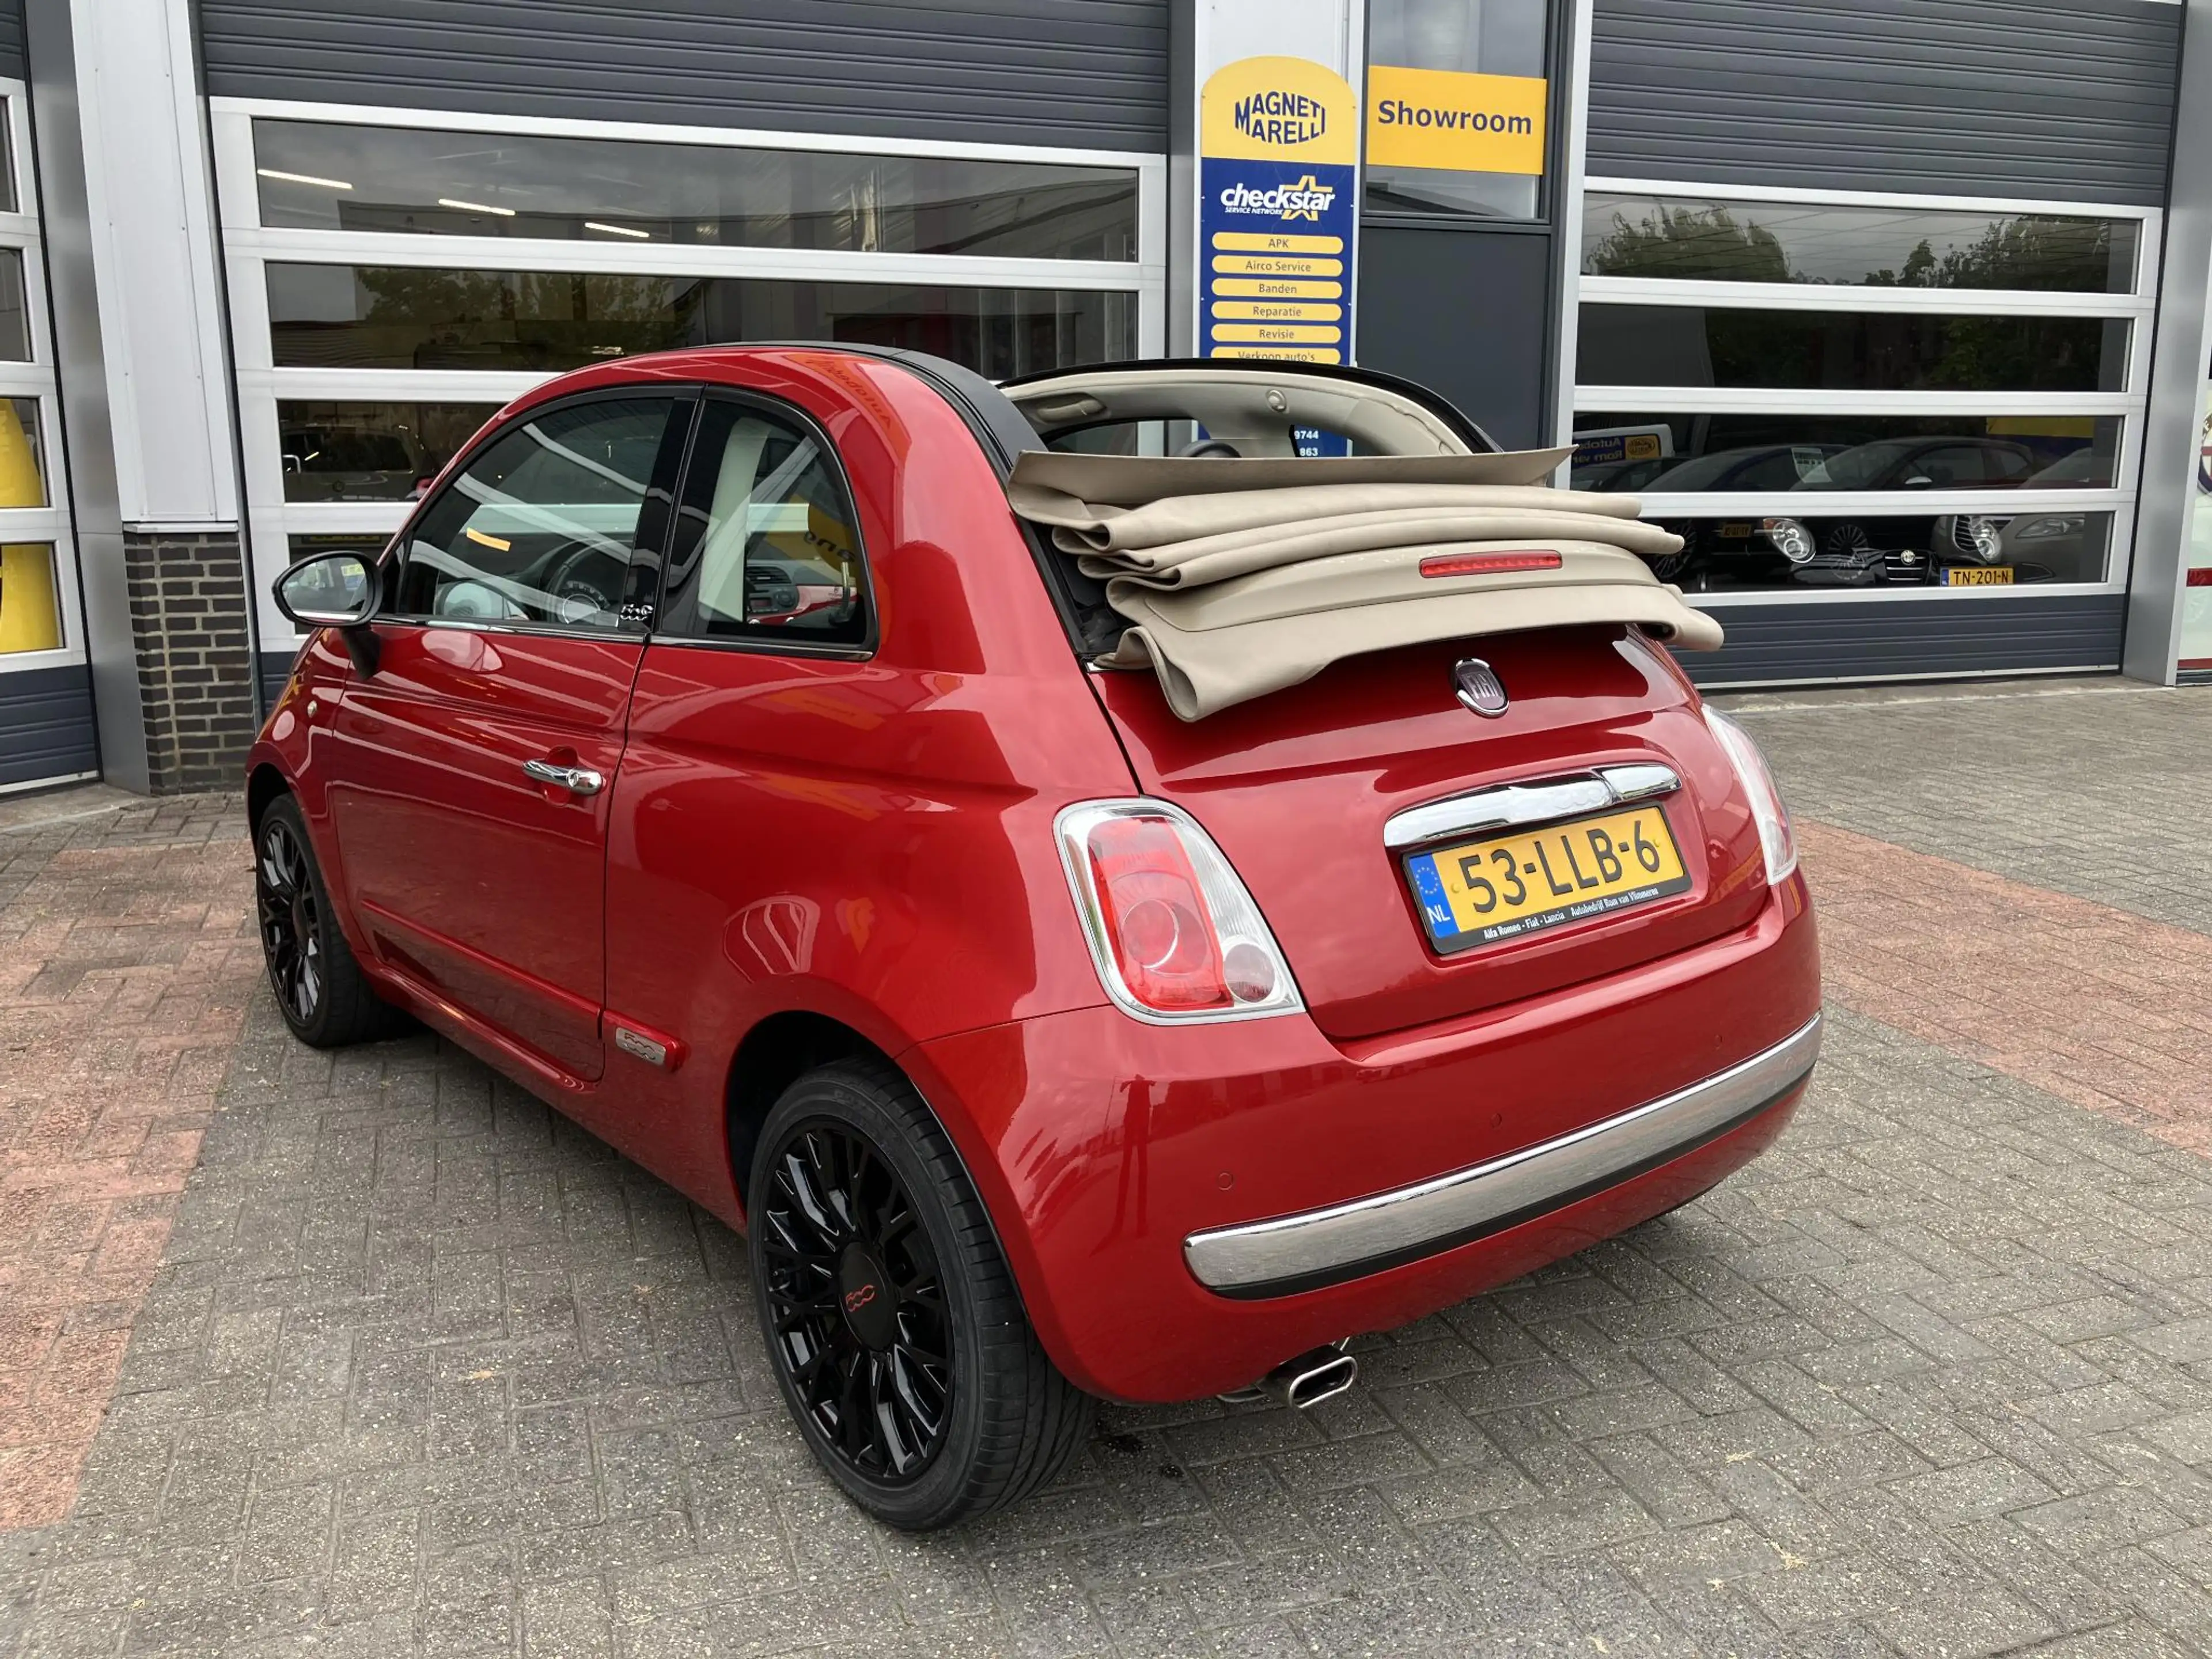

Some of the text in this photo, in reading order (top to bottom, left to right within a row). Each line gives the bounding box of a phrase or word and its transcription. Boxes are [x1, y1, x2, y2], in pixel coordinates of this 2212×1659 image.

[1235, 91, 1326, 127] MAGNETI
[1378, 100, 1532, 135] Showroom
[1235, 107, 1326, 145] MARELLI
[1220, 183, 1336, 211] checkstar
[1268, 238, 1289, 248] APK
[1245, 260, 1311, 272] Airco Service
[1259, 283, 1297, 294] Banden
[1253, 306, 1302, 318] Reparatie
[1259, 328, 1295, 339] Revisie
[1285, 351, 1315, 362] auto's
[1953, 570, 2009, 585] TN-201-N
[1457, 820, 1661, 914] 53-LLB-6
[1426, 904, 1450, 923] NL
[1543, 911, 1566, 924] Lancia
